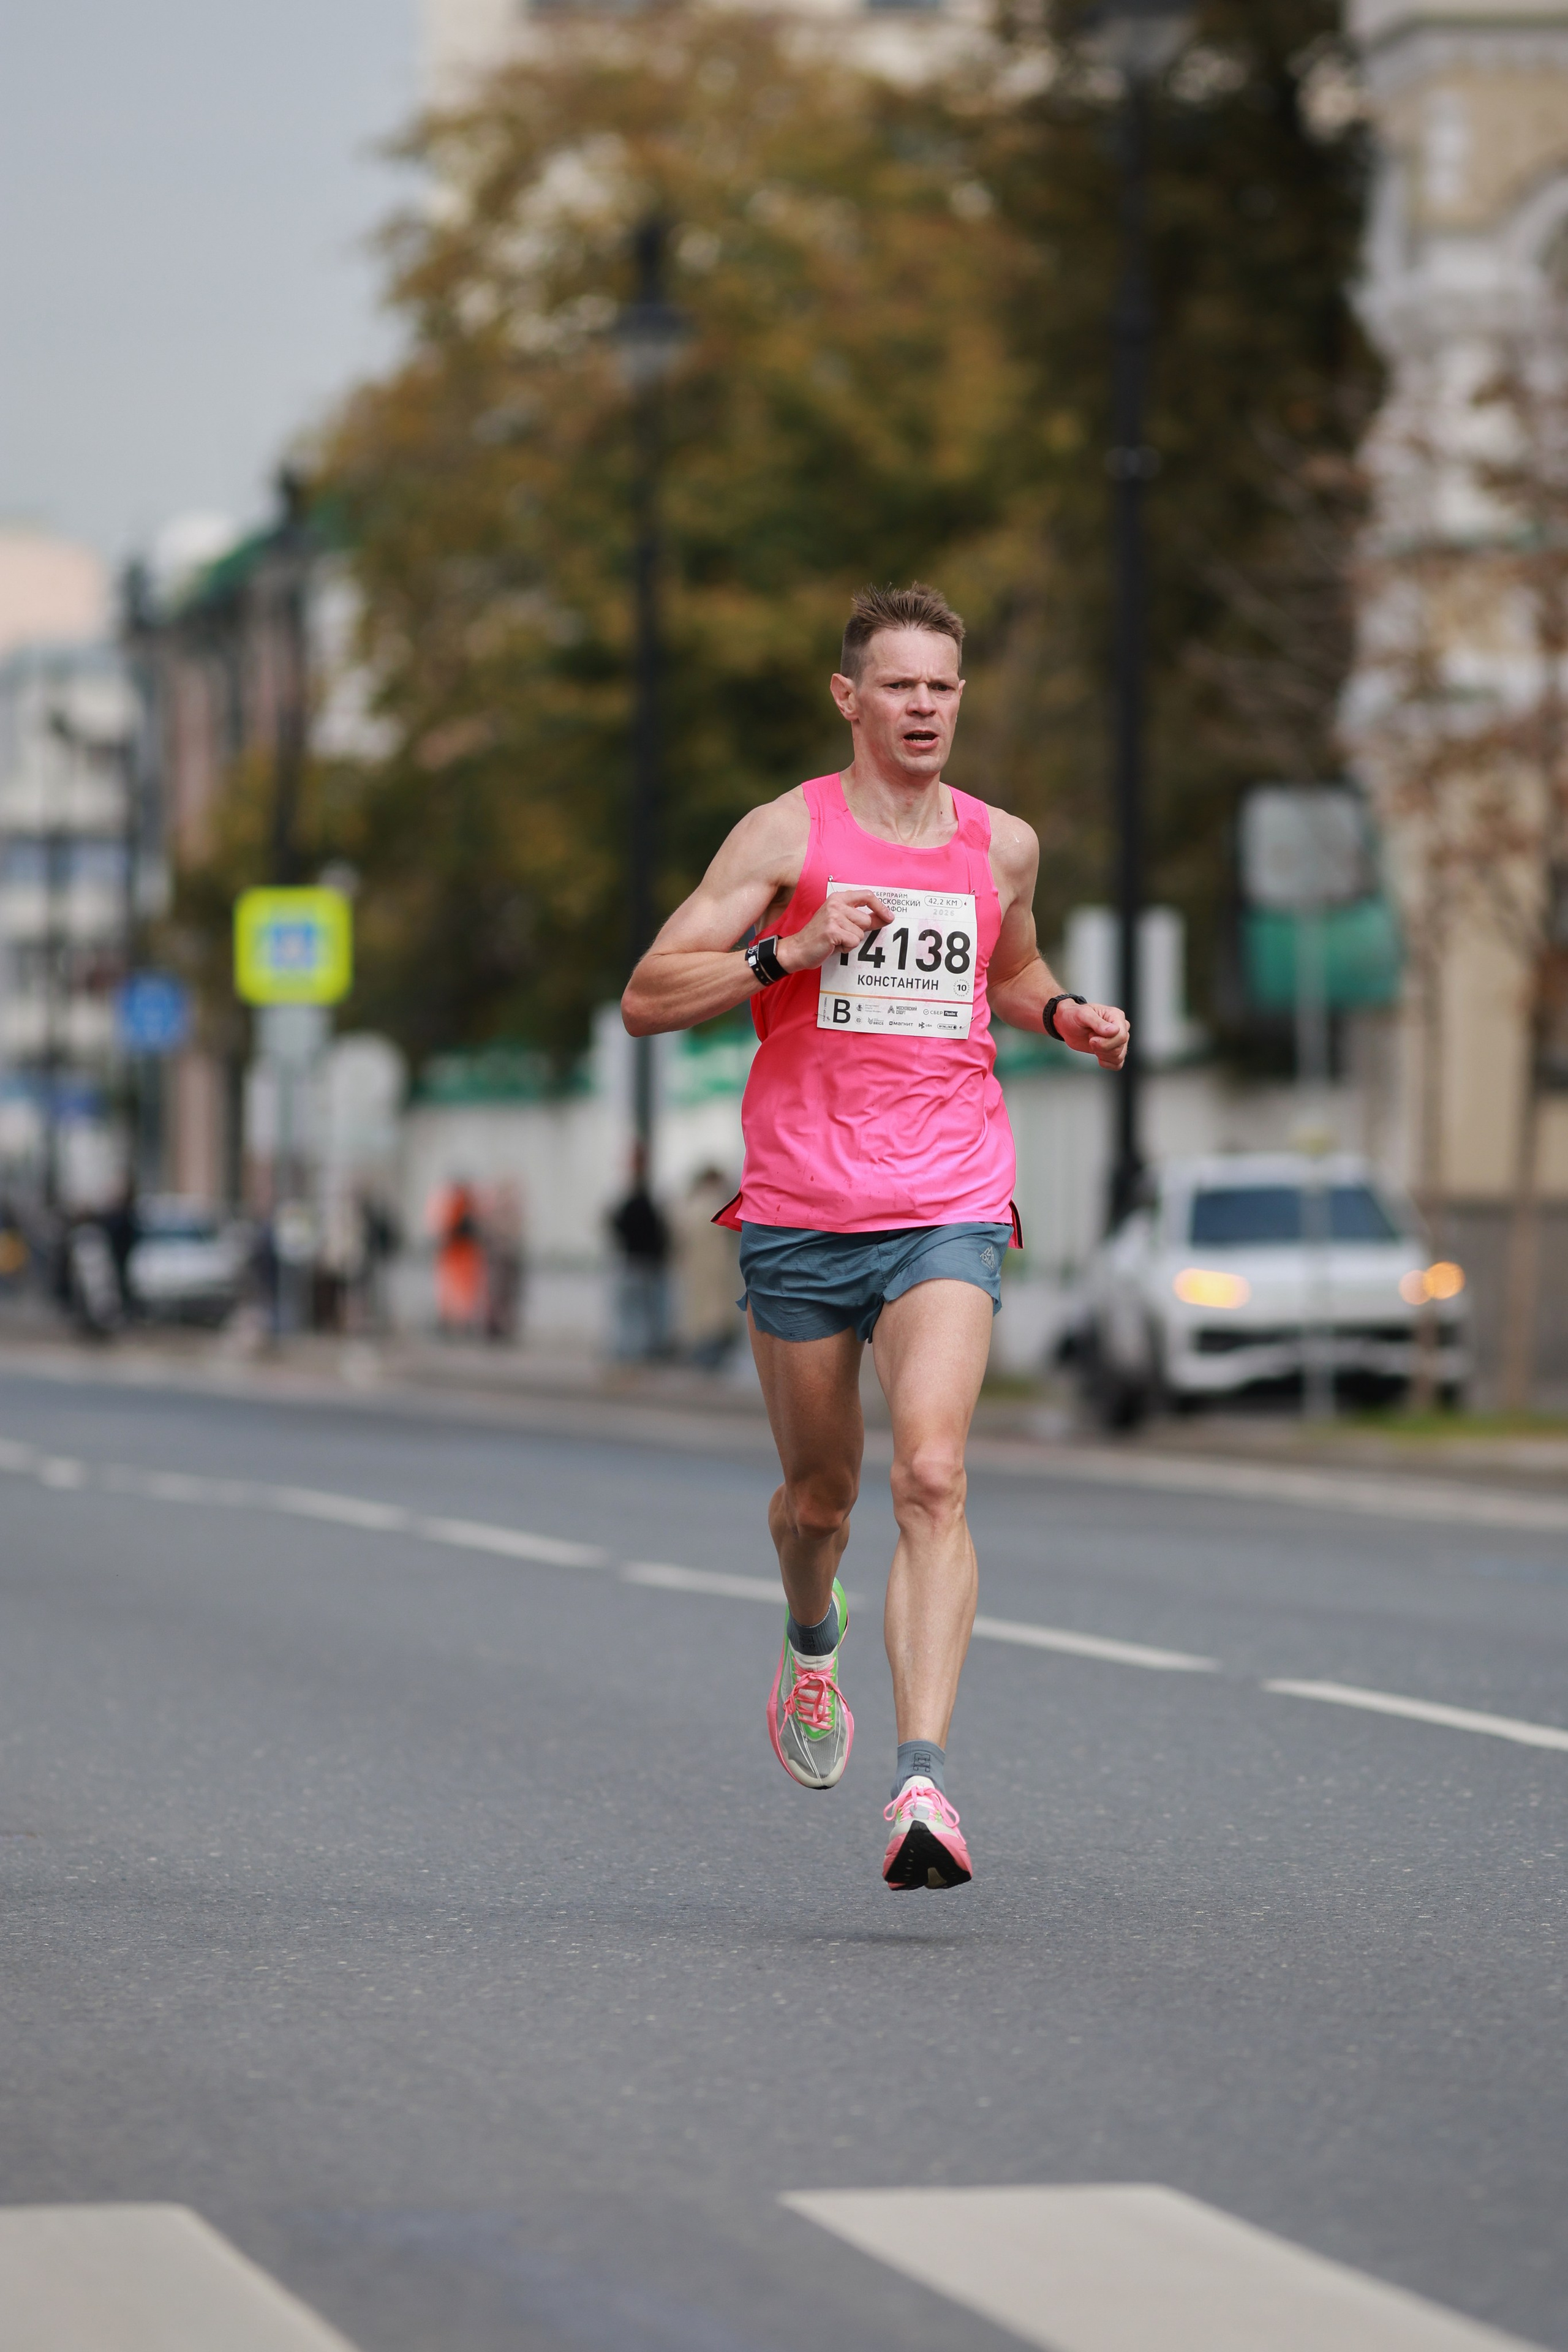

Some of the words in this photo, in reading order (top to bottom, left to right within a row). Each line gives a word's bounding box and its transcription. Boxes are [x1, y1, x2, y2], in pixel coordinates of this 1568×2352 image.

[878, 898, 921, 907] ОСКОВСКИЙ
[840, 927, 970, 974] 4138
[858, 974, 939, 990] КОНСТАНТИН
